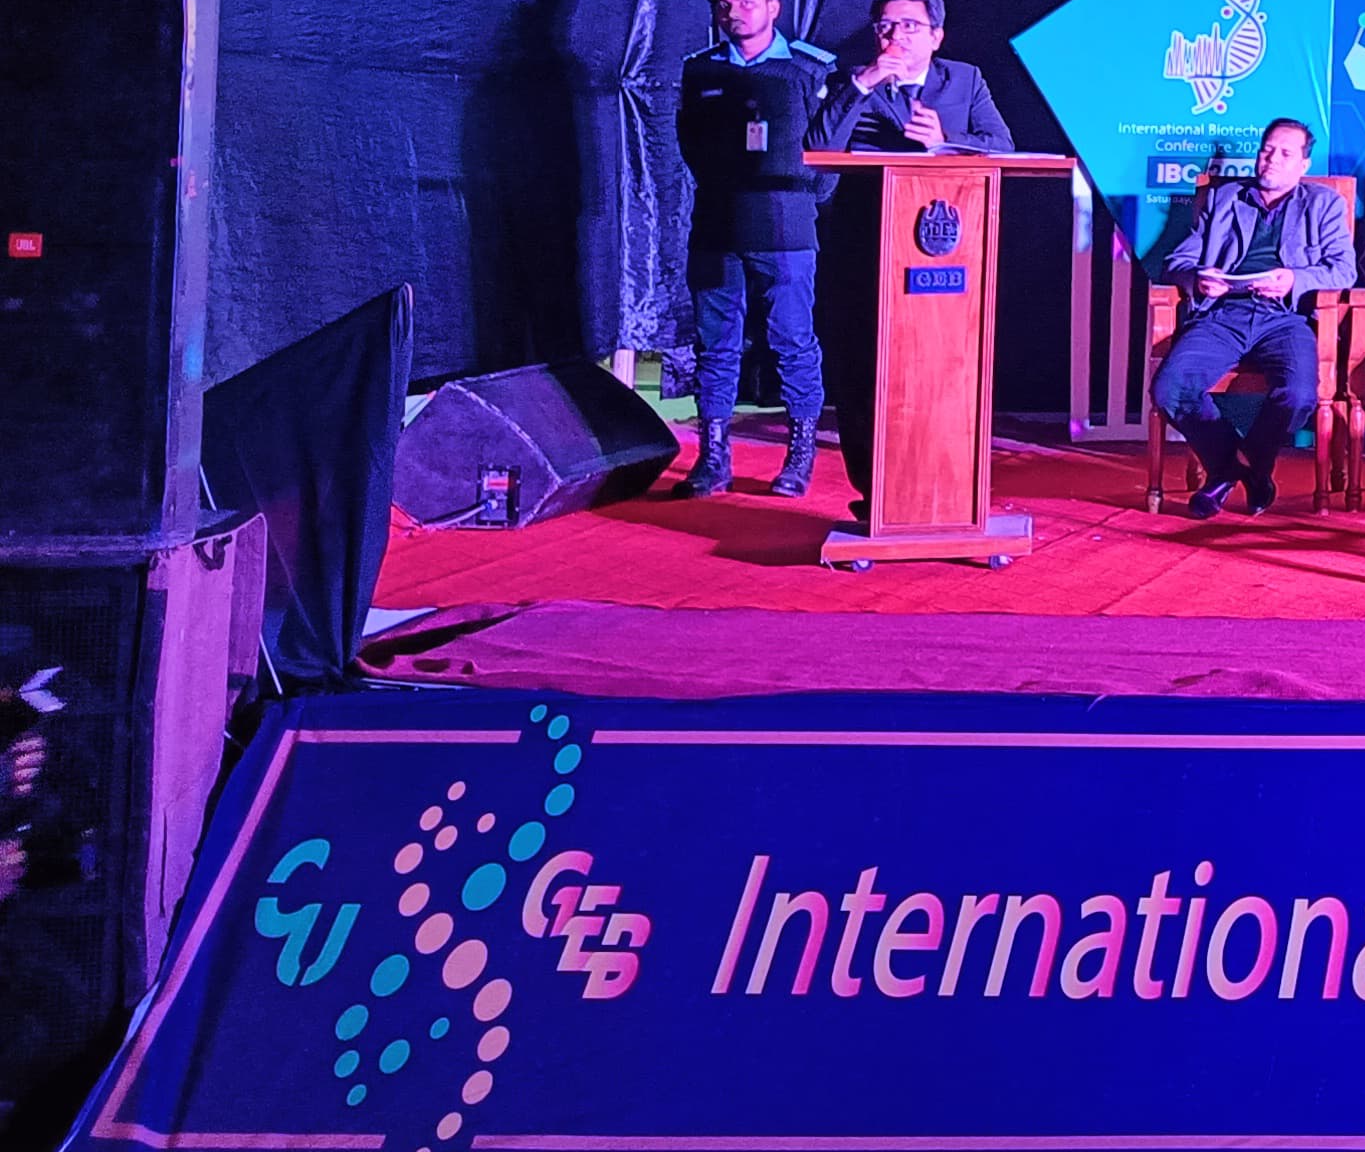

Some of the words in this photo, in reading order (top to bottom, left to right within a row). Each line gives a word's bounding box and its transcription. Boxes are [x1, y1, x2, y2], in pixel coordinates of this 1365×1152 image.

[1118, 121, 1205, 137] International
[1155, 138, 1232, 153] Conference
[1237, 140, 1259, 153] 202
[1156, 162, 1201, 185] IBC
